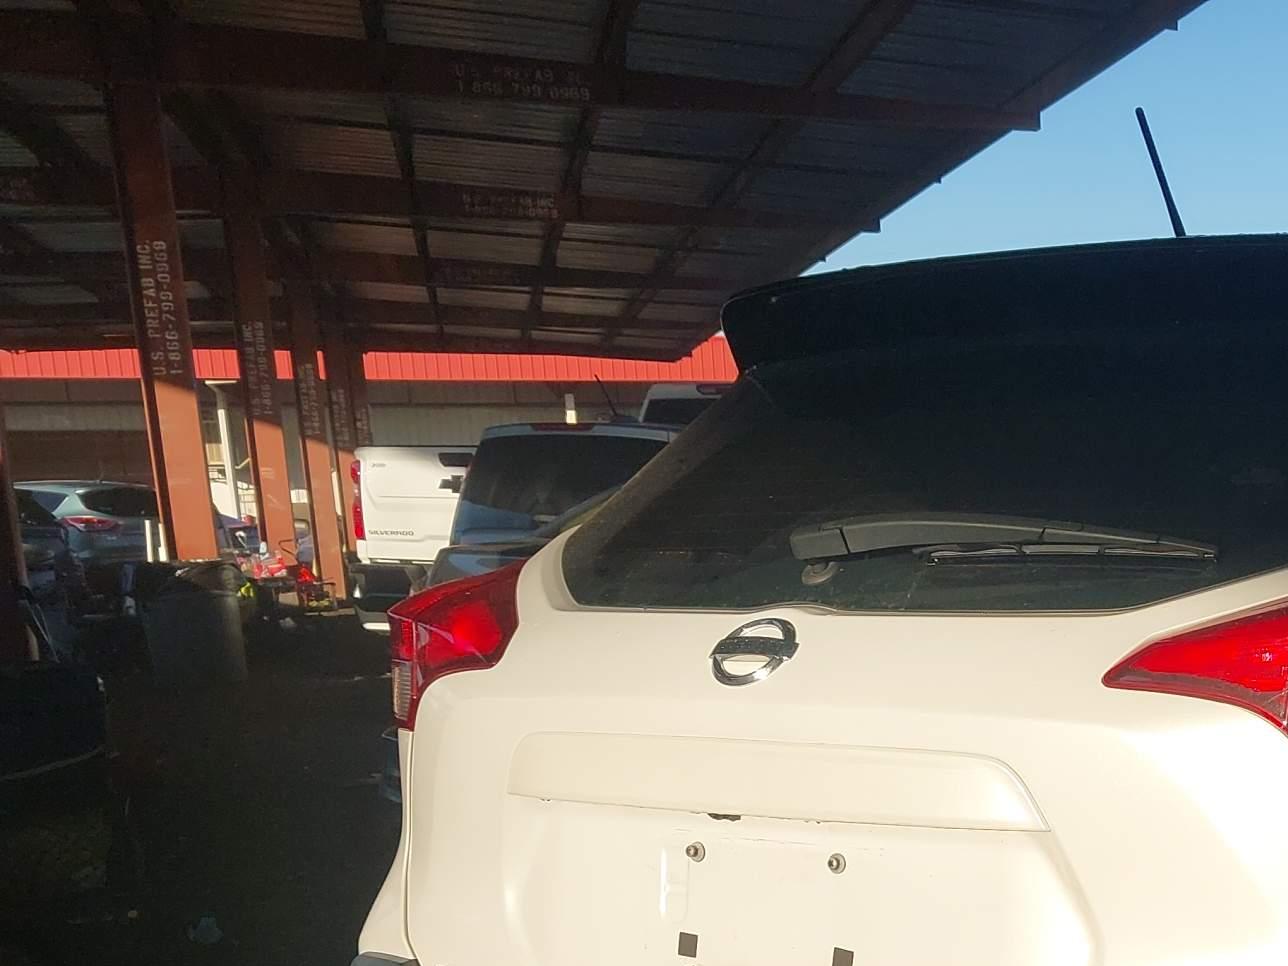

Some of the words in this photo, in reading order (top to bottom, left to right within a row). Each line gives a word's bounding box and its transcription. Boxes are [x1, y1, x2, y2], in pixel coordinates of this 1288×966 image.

[136, 240, 153, 269] INC.
[141, 277, 161, 338] PREFAB
[368, 529, 415, 537] SILVERADO
